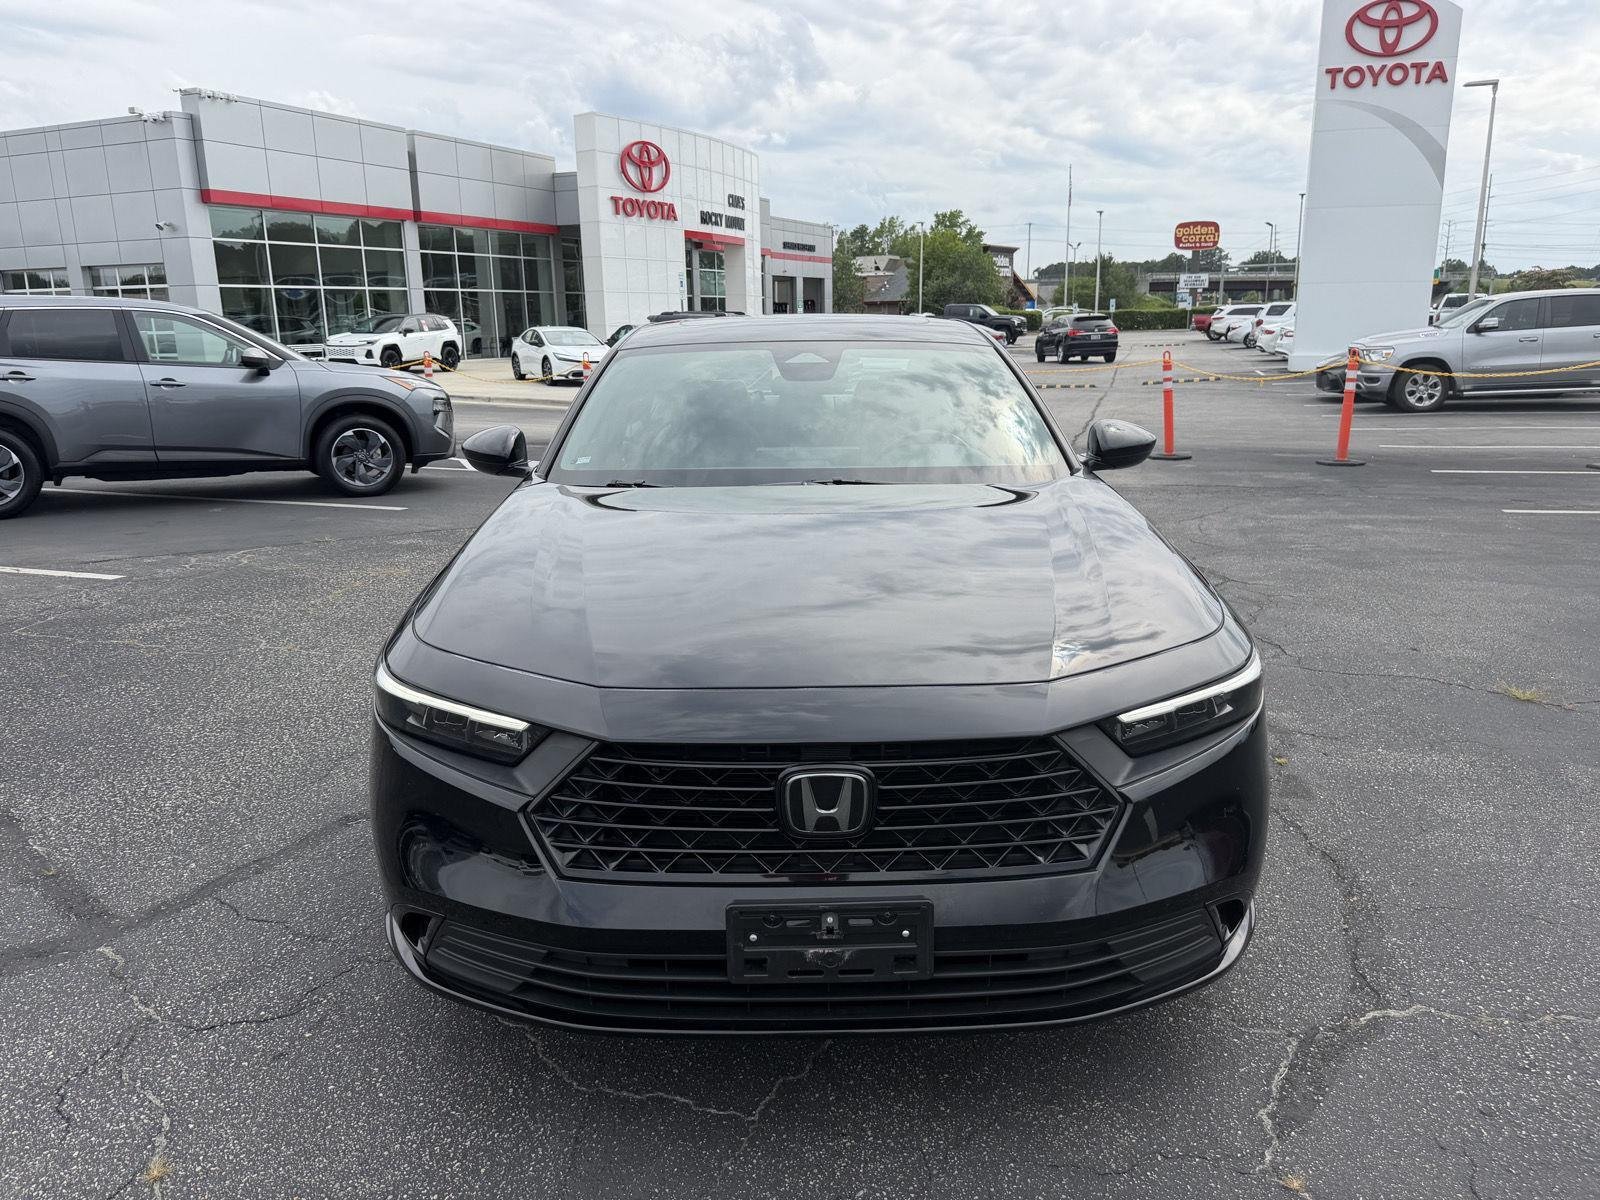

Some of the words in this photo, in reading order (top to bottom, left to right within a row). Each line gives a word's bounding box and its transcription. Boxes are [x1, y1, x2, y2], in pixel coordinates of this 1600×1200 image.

[1325, 61, 1448, 89] TOYOTA
[610, 196, 678, 221] TOYOTA
[700, 210, 723, 227] ROCKY
[1176, 225, 1215, 237] golden
[1182, 232, 1218, 243] corral
